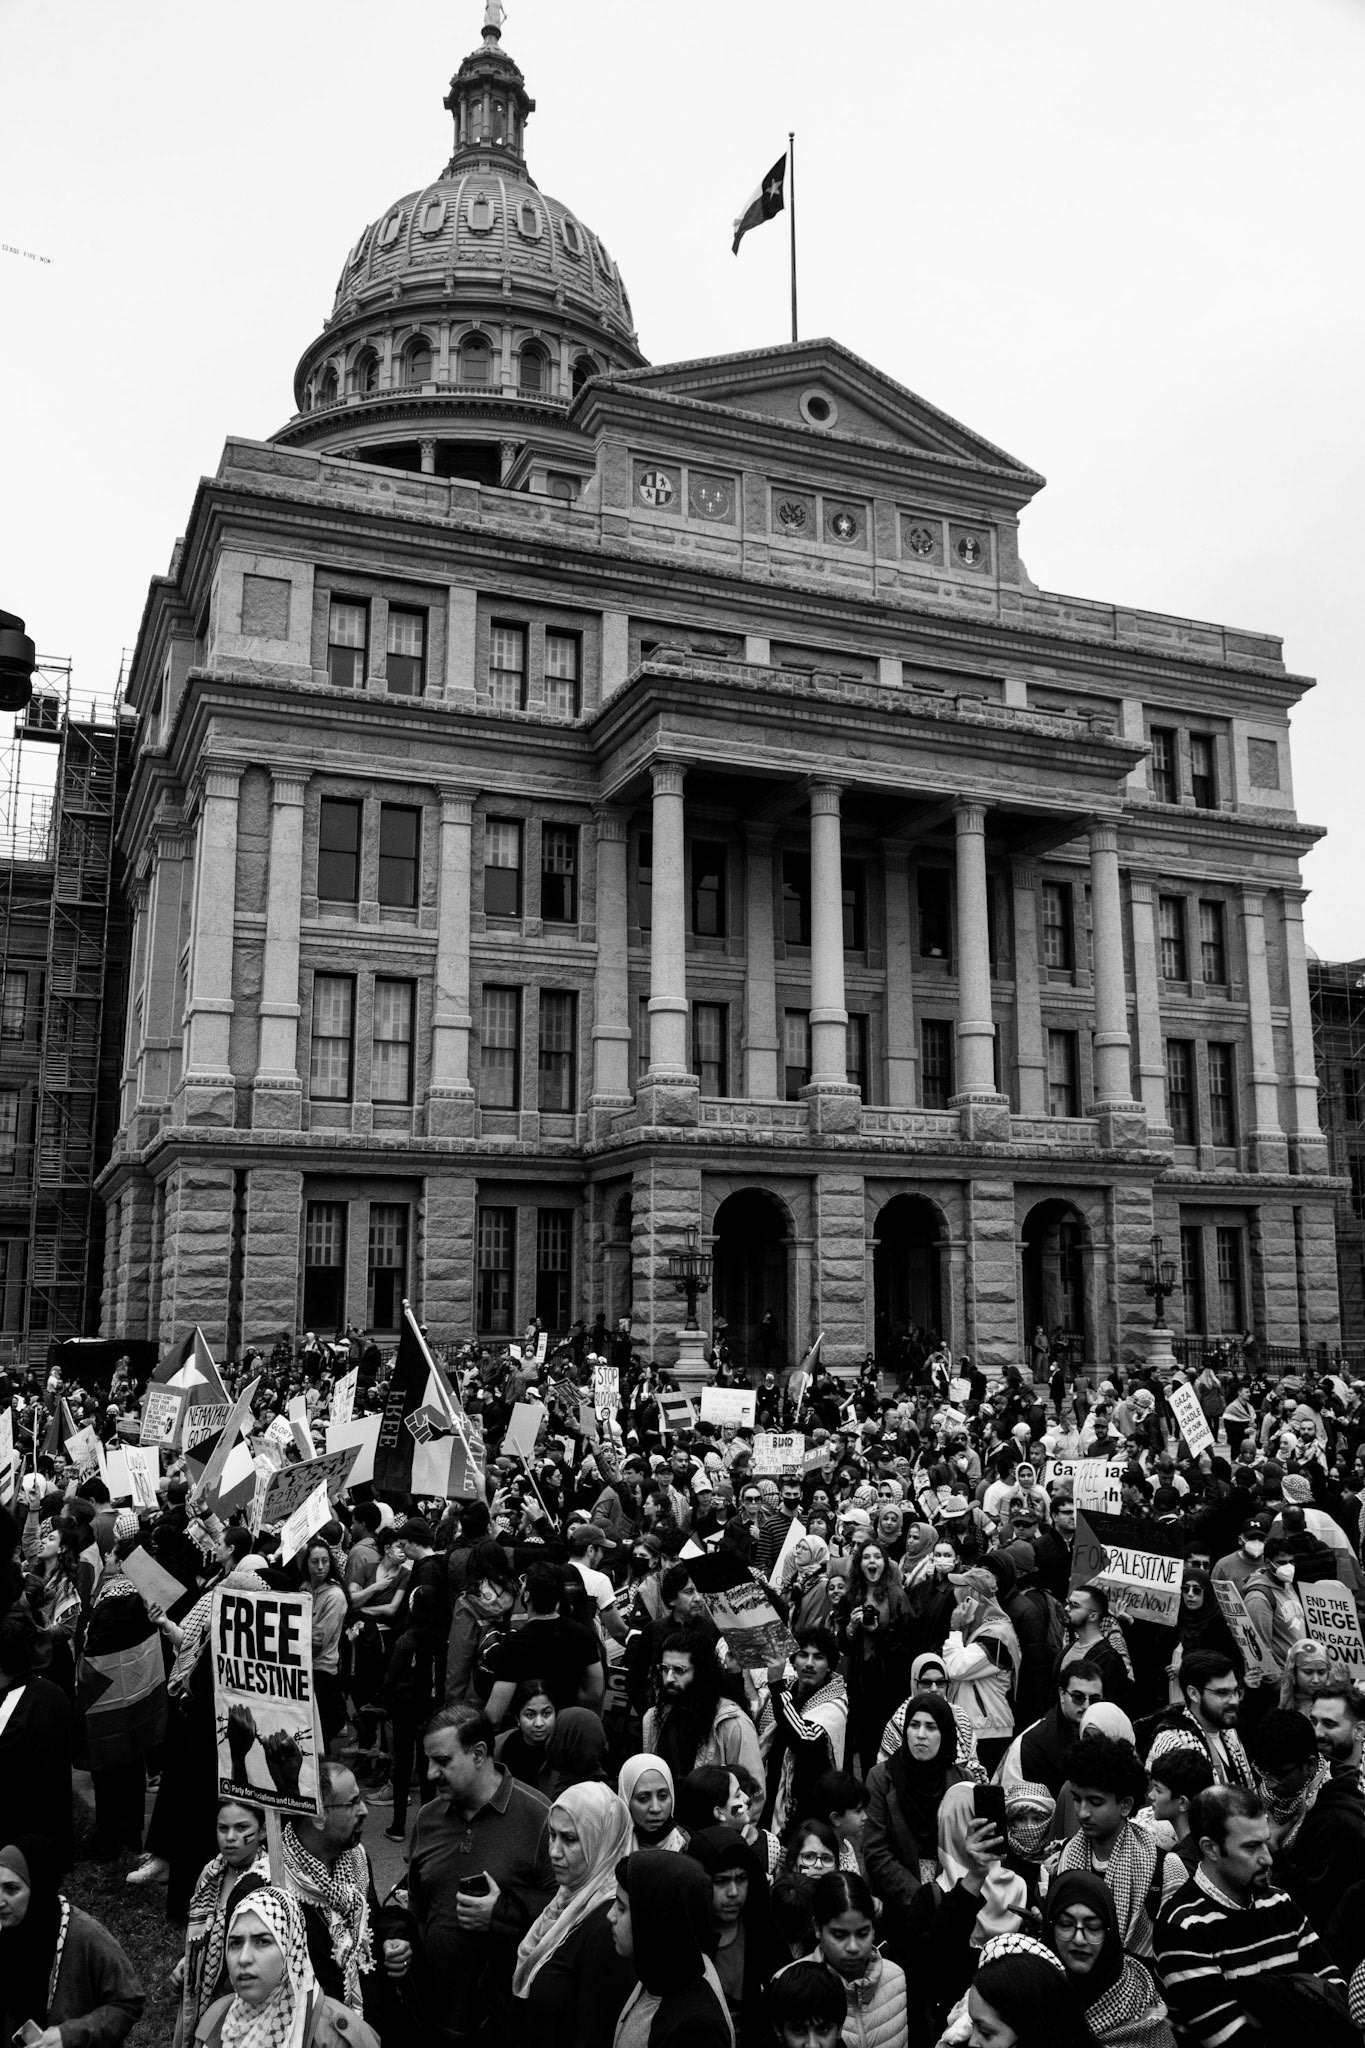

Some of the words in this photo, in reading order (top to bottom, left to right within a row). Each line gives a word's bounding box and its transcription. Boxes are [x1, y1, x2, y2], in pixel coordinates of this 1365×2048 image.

[2, 244, 20, 255] CEASE
[23, 251, 36, 260] FIRE
[598, 1367, 618, 1386] STOP
[159, 1404, 178, 1413] MILLION
[595, 1391, 619, 1407] BLOCKADE
[1174, 1391, 1192, 1408] GAZA
[1184, 1402, 1193, 1413] THE
[187, 1405, 235, 1427] NETANYAHU
[1180, 1407, 1202, 1429] CRADLE
[271, 1422, 293, 1439] GLORY
[1186, 1428, 1193, 1436] OF
[1192, 1420, 1202, 1432] OUR
[1188, 1426, 1211, 1448] STRUGGLE
[188, 1430, 199, 1449] GO
[275, 1435, 283, 1444] ALL
[755, 1436, 771, 1447] THE
[773, 1437, 794, 1448] BLOOD
[795, 1437, 803, 1445] IS
[755, 1448, 764, 1456] ON
[766, 1448, 777, 1456] THE
[804, 1451, 817, 1462] END
[817, 1446, 828, 1457] THE
[1077, 1462, 1101, 1493] FREE
[266, 1484, 303, 1506] $298
[1074, 1544, 1111, 1573] FOR
[1109, 1549, 1181, 1584] PALESTINE
[1305, 1596, 1326, 1608] END
[1328, 1599, 1349, 1611] THE
[1308, 1608, 1357, 1631] SIEGE
[220, 1594, 302, 1666] FREE
[1311, 1629, 1326, 1642] ON
[1328, 1634, 1363, 1648] GAZA
[1321, 1643, 1365, 1665] OW!
[217, 1654, 310, 1701] PALESTINE
[231, 1784, 245, 1796] Party
[245, 1787, 253, 1796] for
[276, 1796, 288, 1805] and
[287, 1797, 316, 1810] Liberation
